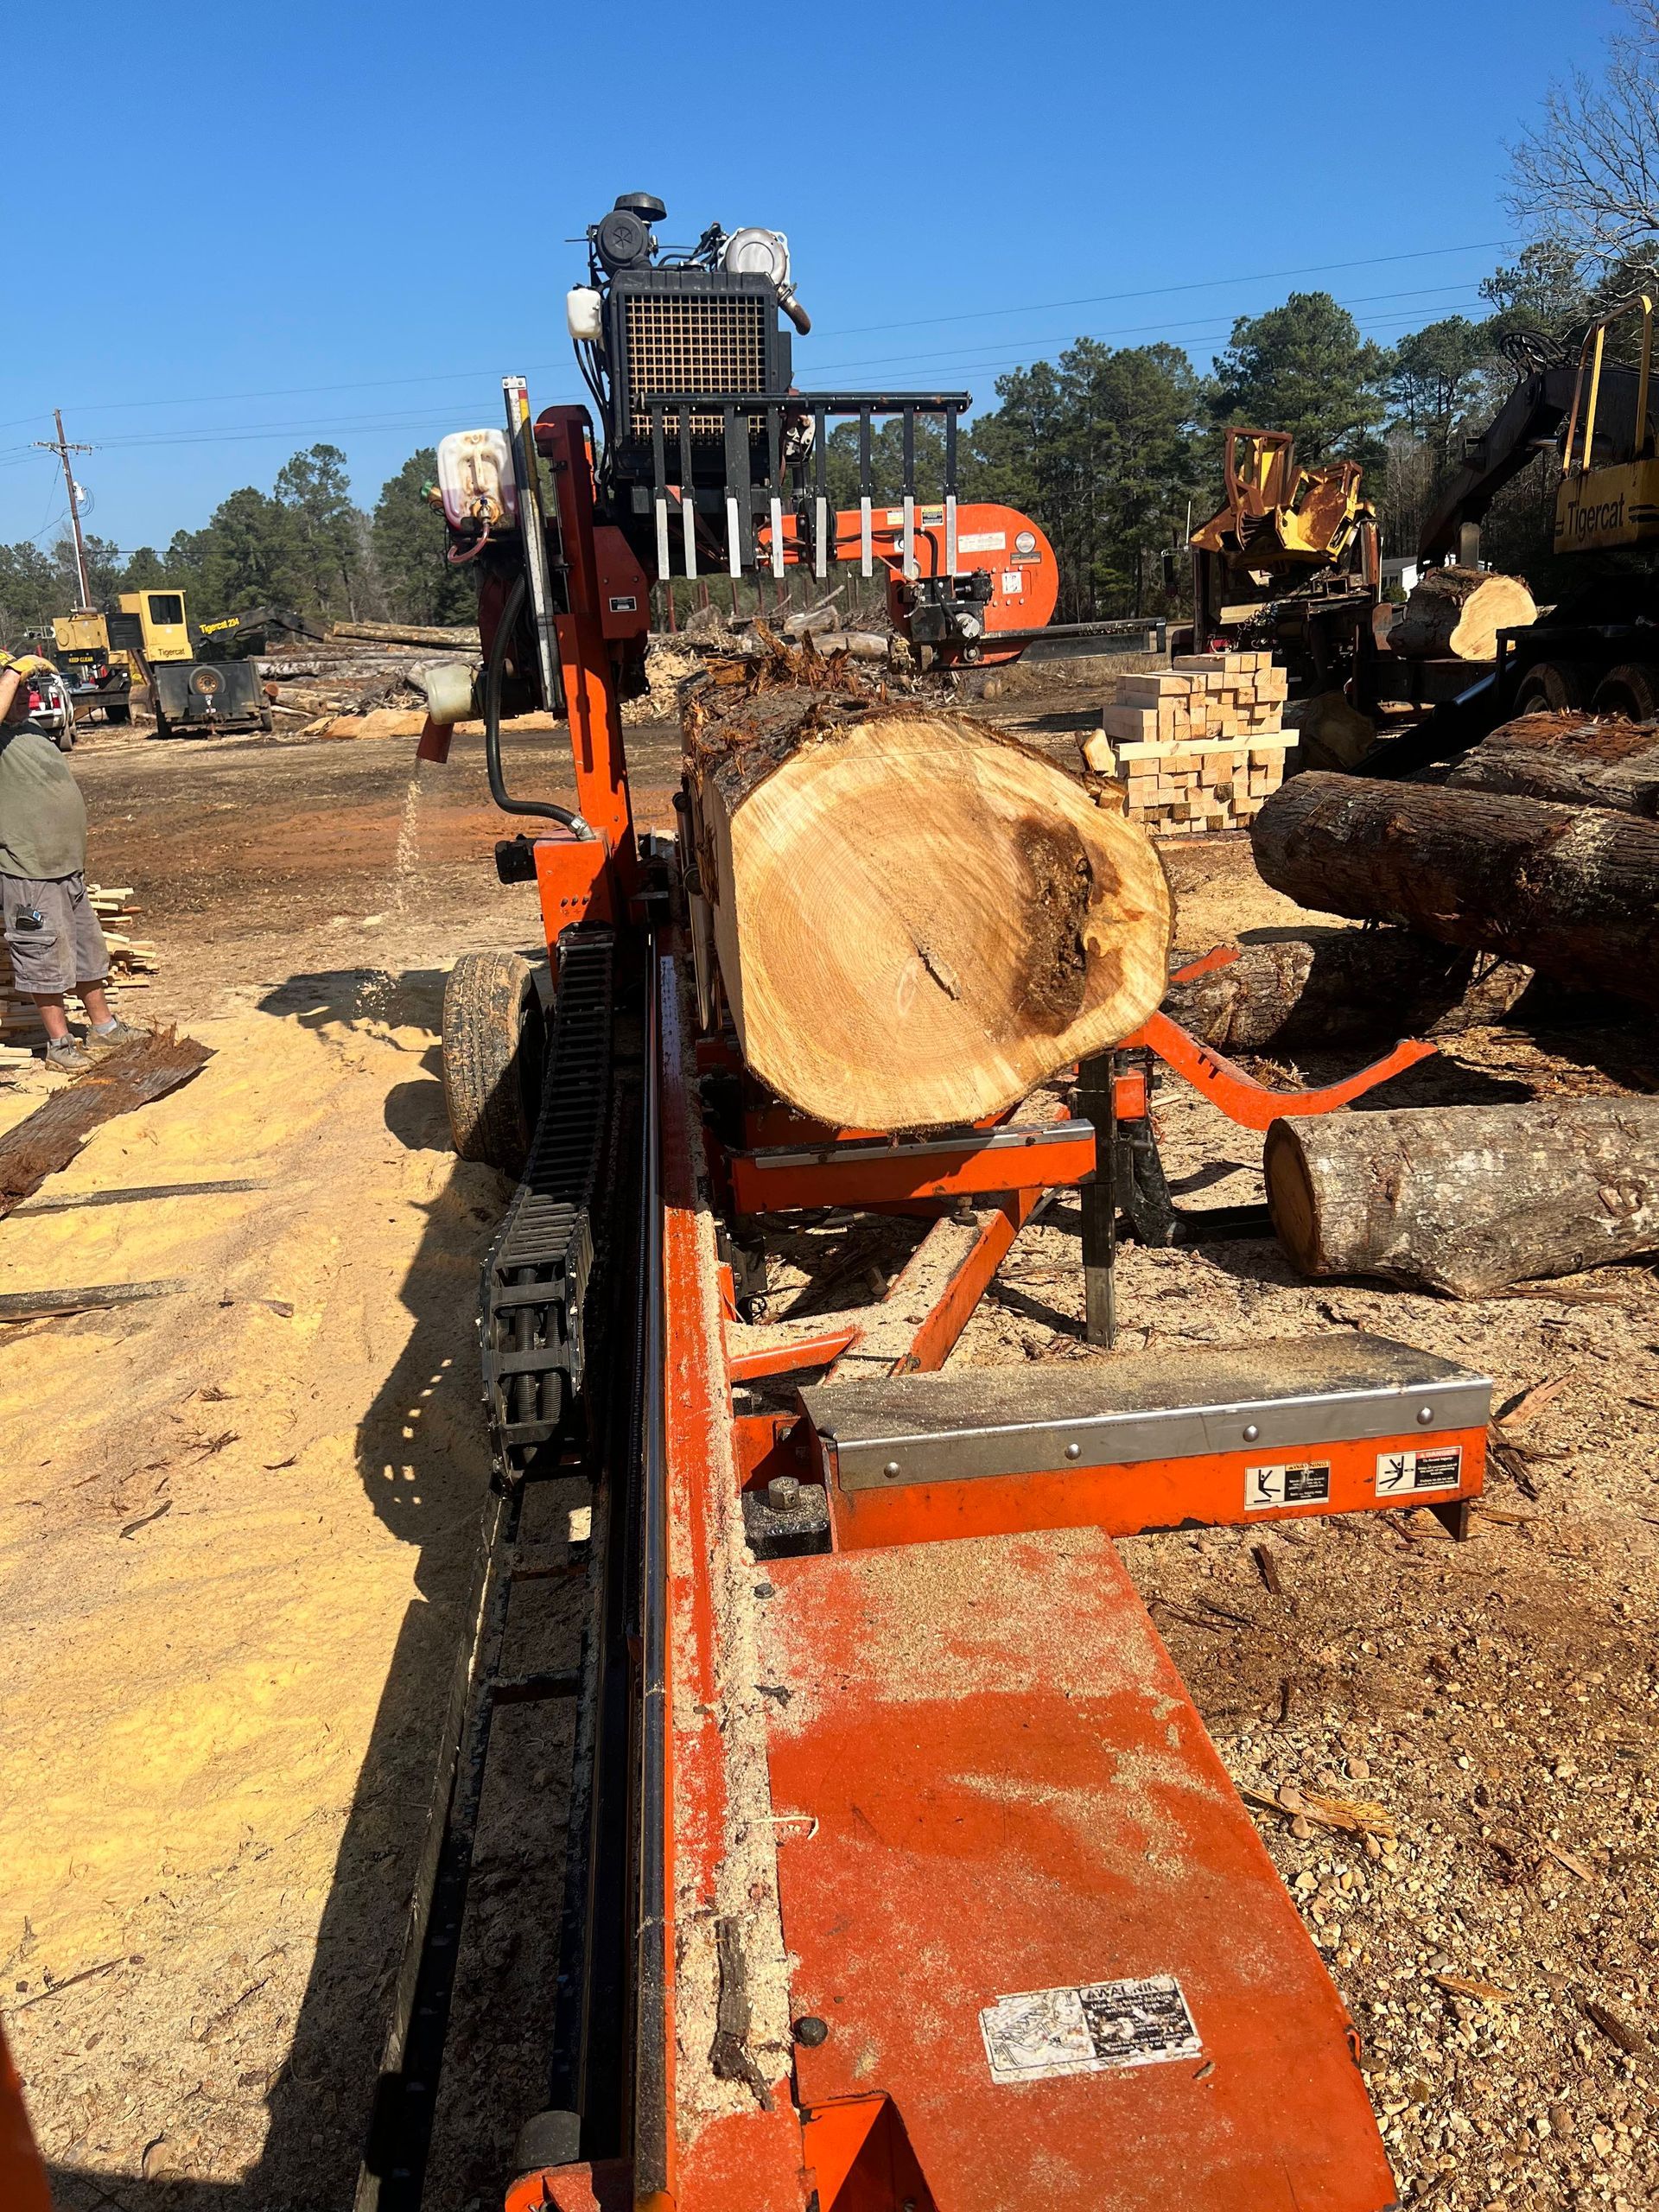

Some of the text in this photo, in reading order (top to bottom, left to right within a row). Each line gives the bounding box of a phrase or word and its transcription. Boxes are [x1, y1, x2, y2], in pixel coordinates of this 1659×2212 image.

[1567, 492, 1625, 543] Tigercat
[199, 617, 240, 635] Tigercat 234
[158, 648, 186, 658] Tigercat
